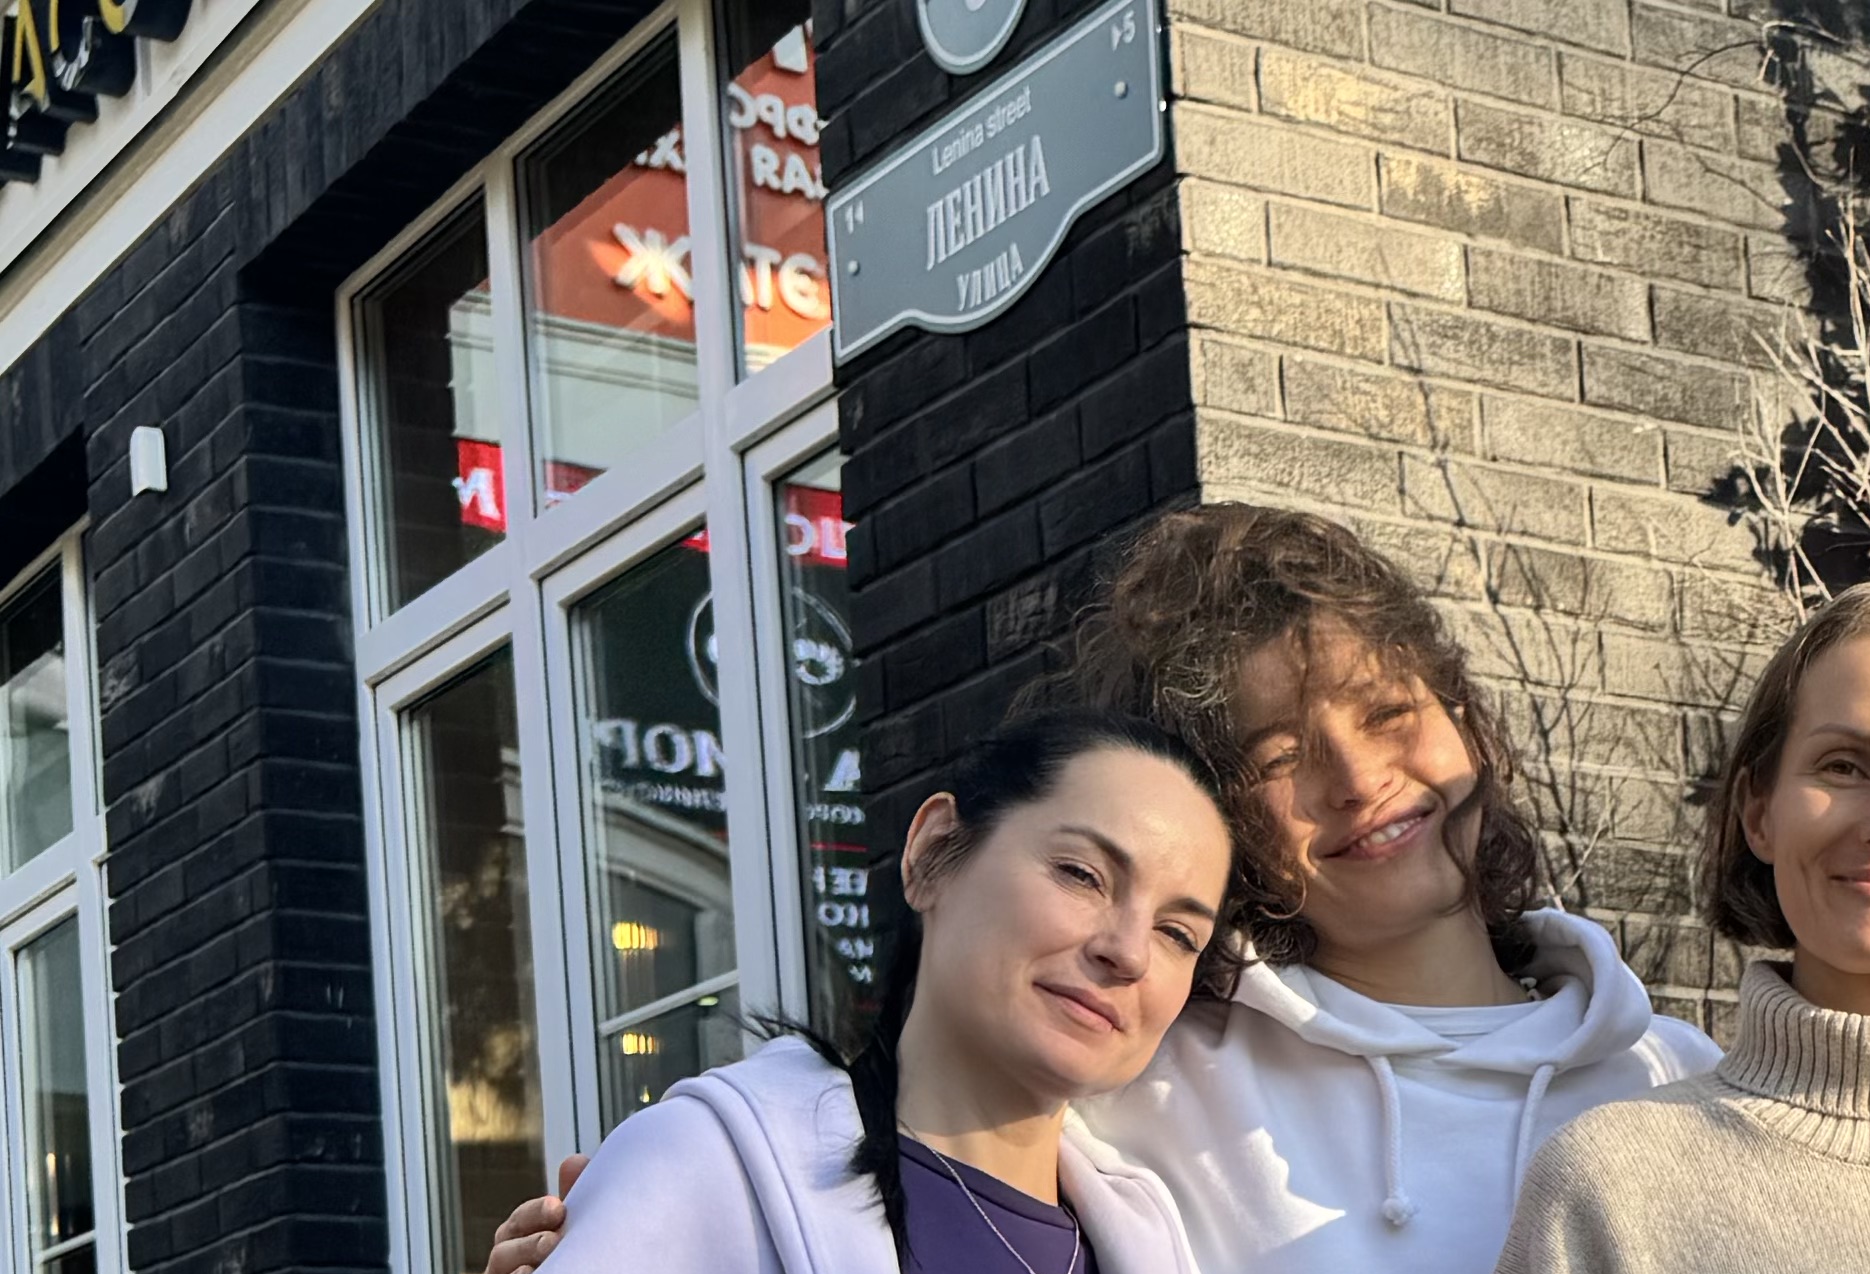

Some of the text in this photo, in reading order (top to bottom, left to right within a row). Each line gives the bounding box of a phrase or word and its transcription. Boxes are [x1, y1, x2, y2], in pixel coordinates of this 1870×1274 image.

[931, 85, 1032, 176] Lenina street
[926, 134, 1051, 271] ЛЕНИНА
[956, 242, 1024, 311] УЛИЦА
